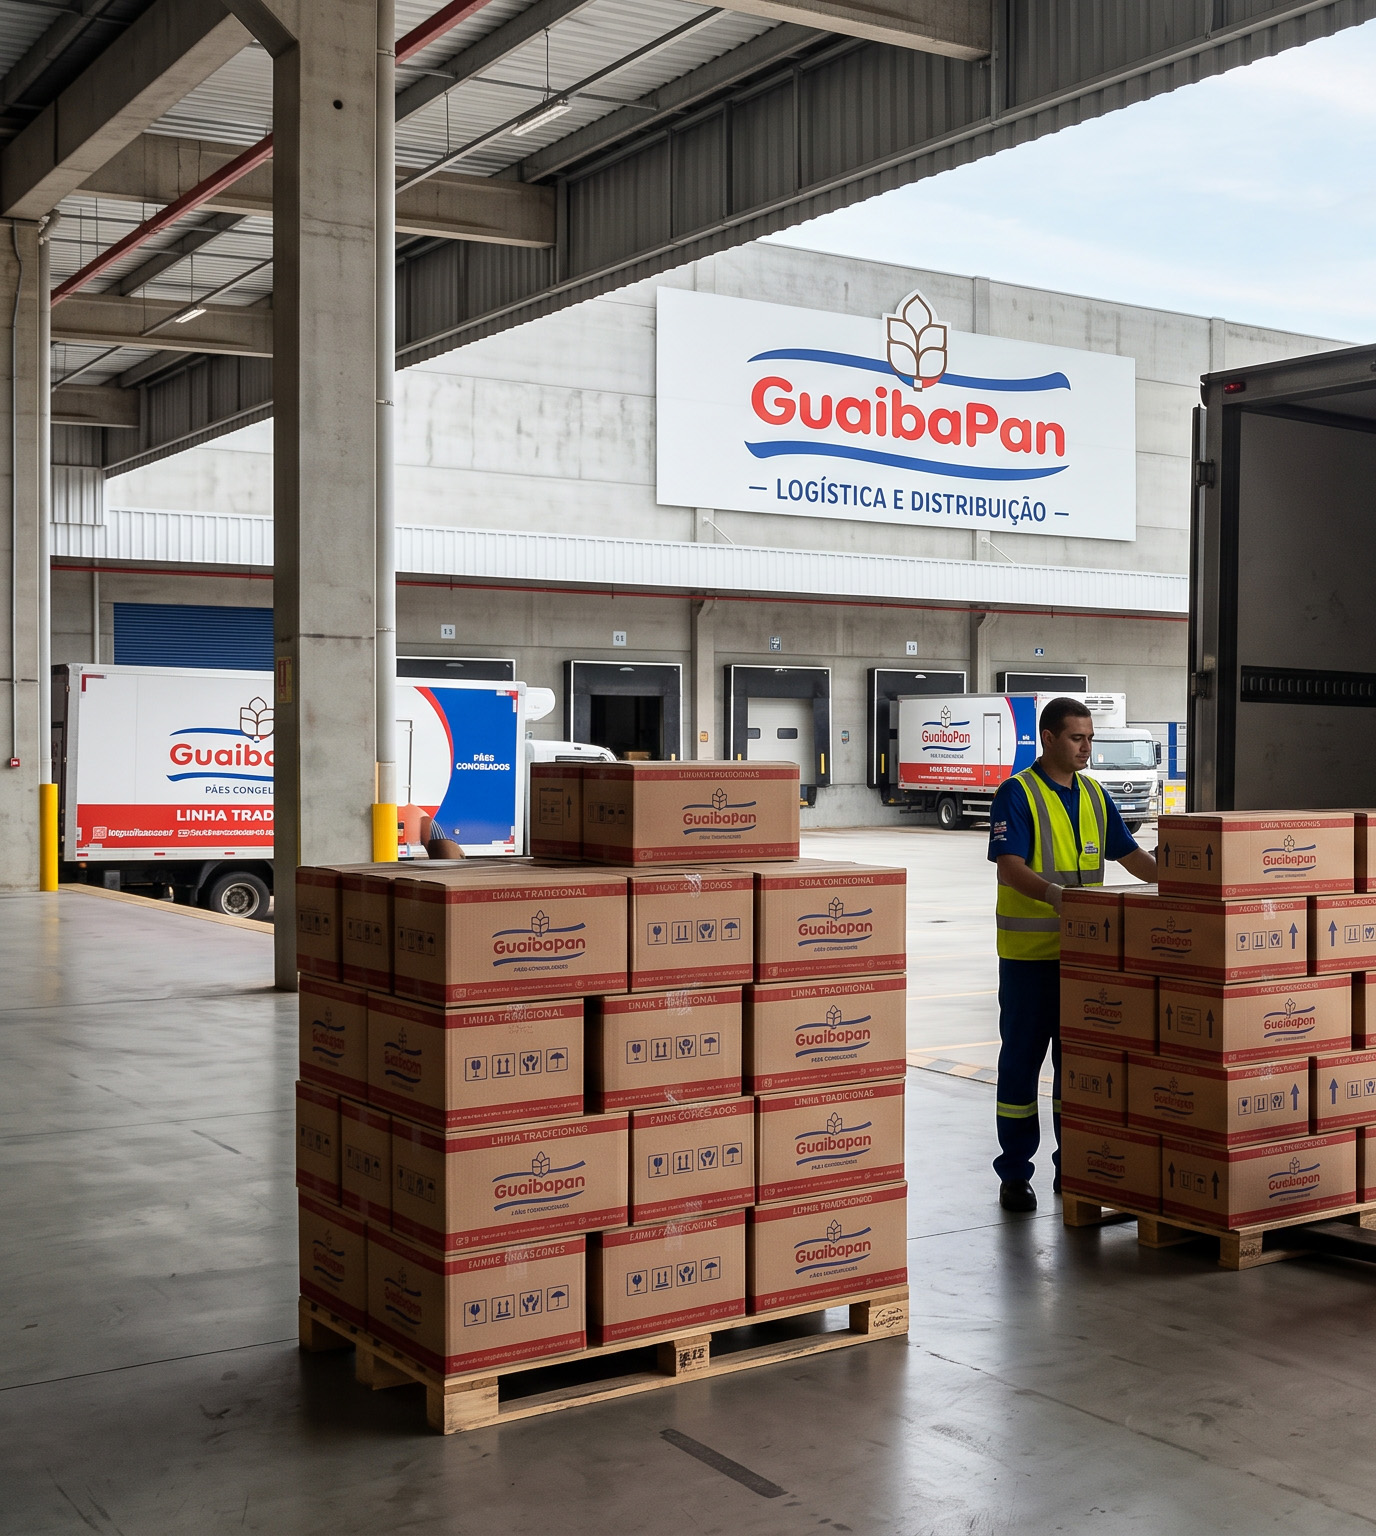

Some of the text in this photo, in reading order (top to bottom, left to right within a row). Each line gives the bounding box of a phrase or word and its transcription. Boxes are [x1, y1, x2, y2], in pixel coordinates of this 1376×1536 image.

[751, 375, 1066, 457] GuaibaPan
[776, 475, 1047, 525] LOGÍSTICA E DISTRIBUIÇÃO
[169, 743, 274, 767] Guaiba
[233, 786, 274, 795] CONGEL
[176, 809, 227, 821] LINHA
